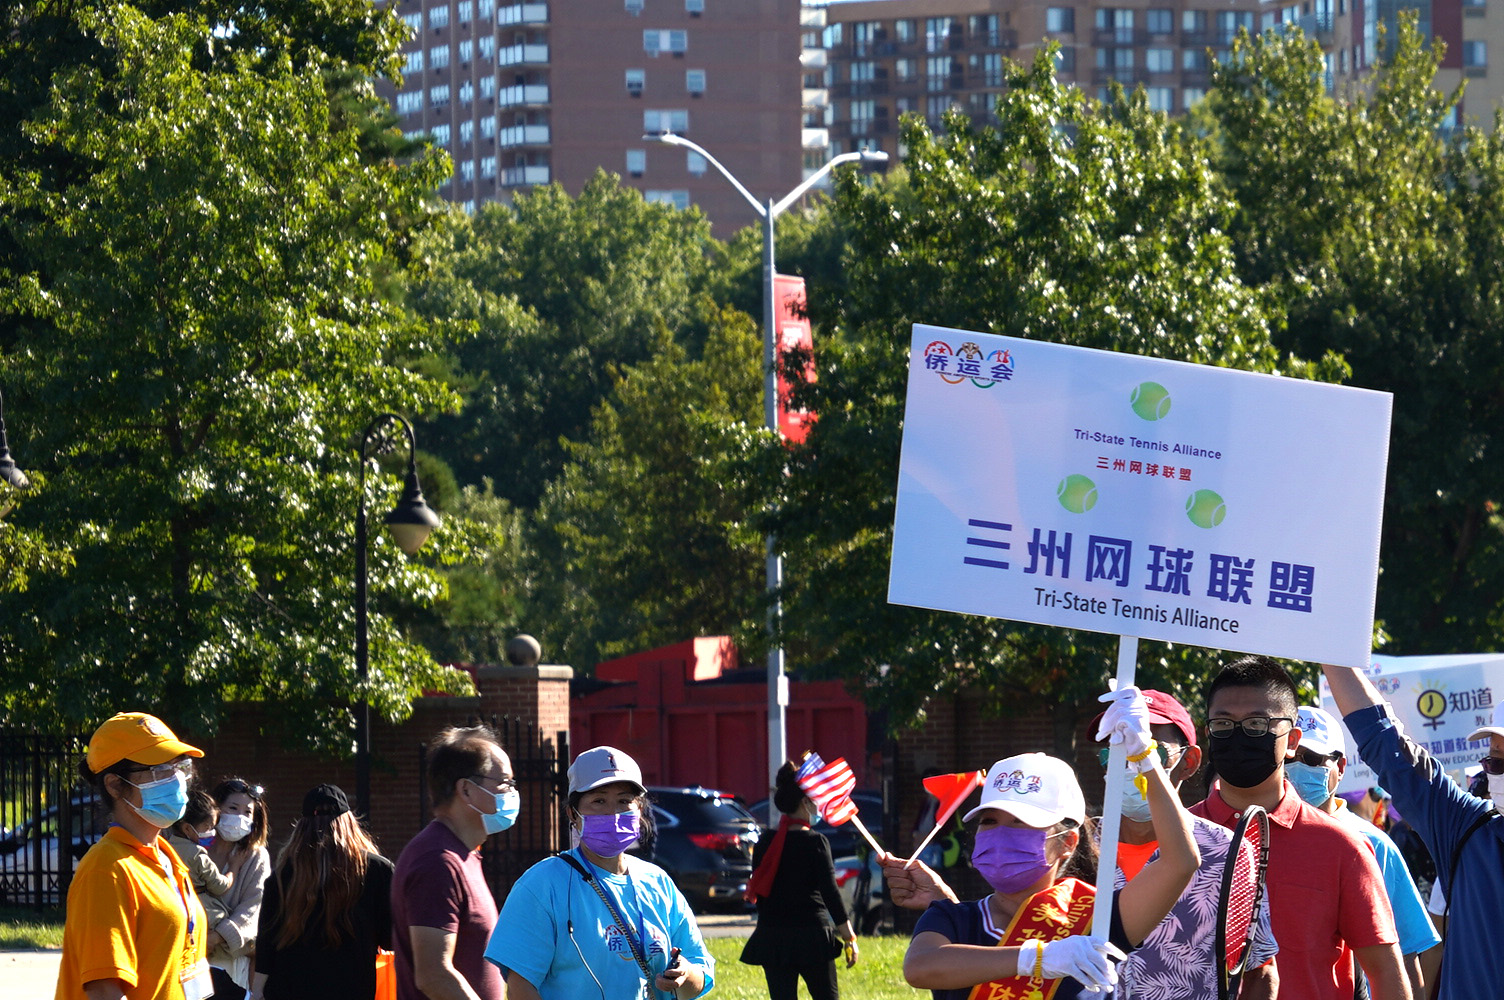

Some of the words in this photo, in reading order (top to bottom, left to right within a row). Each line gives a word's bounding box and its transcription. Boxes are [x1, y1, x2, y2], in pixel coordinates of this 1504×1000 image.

[925, 353, 1013, 380] 侨运会
[1074, 428, 1125, 446] Tri-State
[1129, 436, 1169, 452] Tennis
[1172, 443, 1222, 460] Alliance
[1096, 456, 1192, 482] 三州网球联盟
[963, 518, 1316, 613] 三州网球联盟
[1033, 587, 1107, 616] Tri-State
[1111, 597, 1168, 624] Tennis
[1171, 606, 1240, 634] Alliance
[1449, 687, 1493, 713] 知道
[1251, 846, 1270, 923] HEAD
